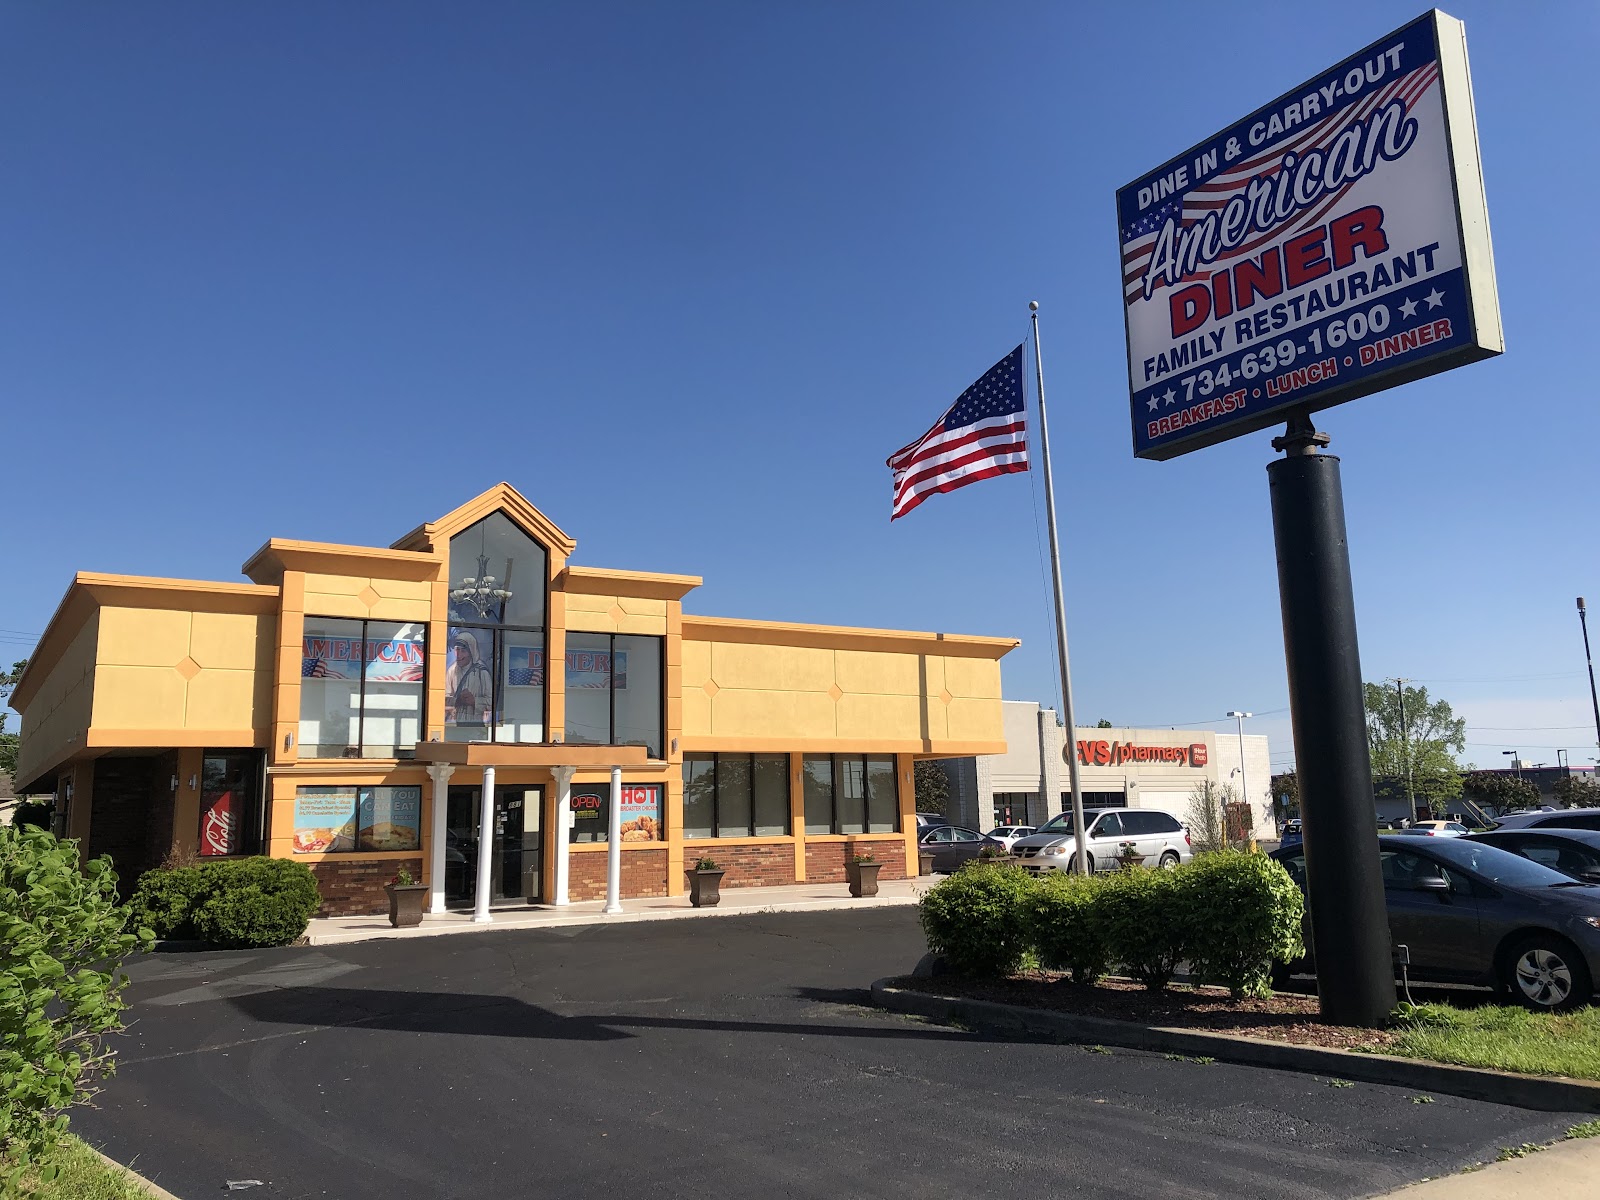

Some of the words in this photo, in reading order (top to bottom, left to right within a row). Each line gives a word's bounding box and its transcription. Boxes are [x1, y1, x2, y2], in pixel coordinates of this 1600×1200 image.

[1138, 169, 1189, 210] DINE
[1195, 149, 1218, 180] IN
[1224, 136, 1242, 161] &
[1248, 42, 1405, 146] CARRY-OUT
[1143, 98, 1417, 299] American
[1143, 325, 1235, 382] FAMILY
[1236, 242, 1440, 345] RESTAURANT
[1169, 204, 1389, 339] DINER
[1147, 389, 1248, 439] BREAKFAST
[1266, 357, 1338, 397] LUNCH
[1359, 318, 1452, 367] DINNER
[1181, 303, 1391, 401] 734-639-1600
[528, 650, 611, 673] DNER
[366, 791, 385, 800] ALL
[390, 791, 416, 800] YOU
[394, 801, 415, 811] EAT
[571, 796, 600, 808] OPEN
[621, 786, 658, 805] HOT
